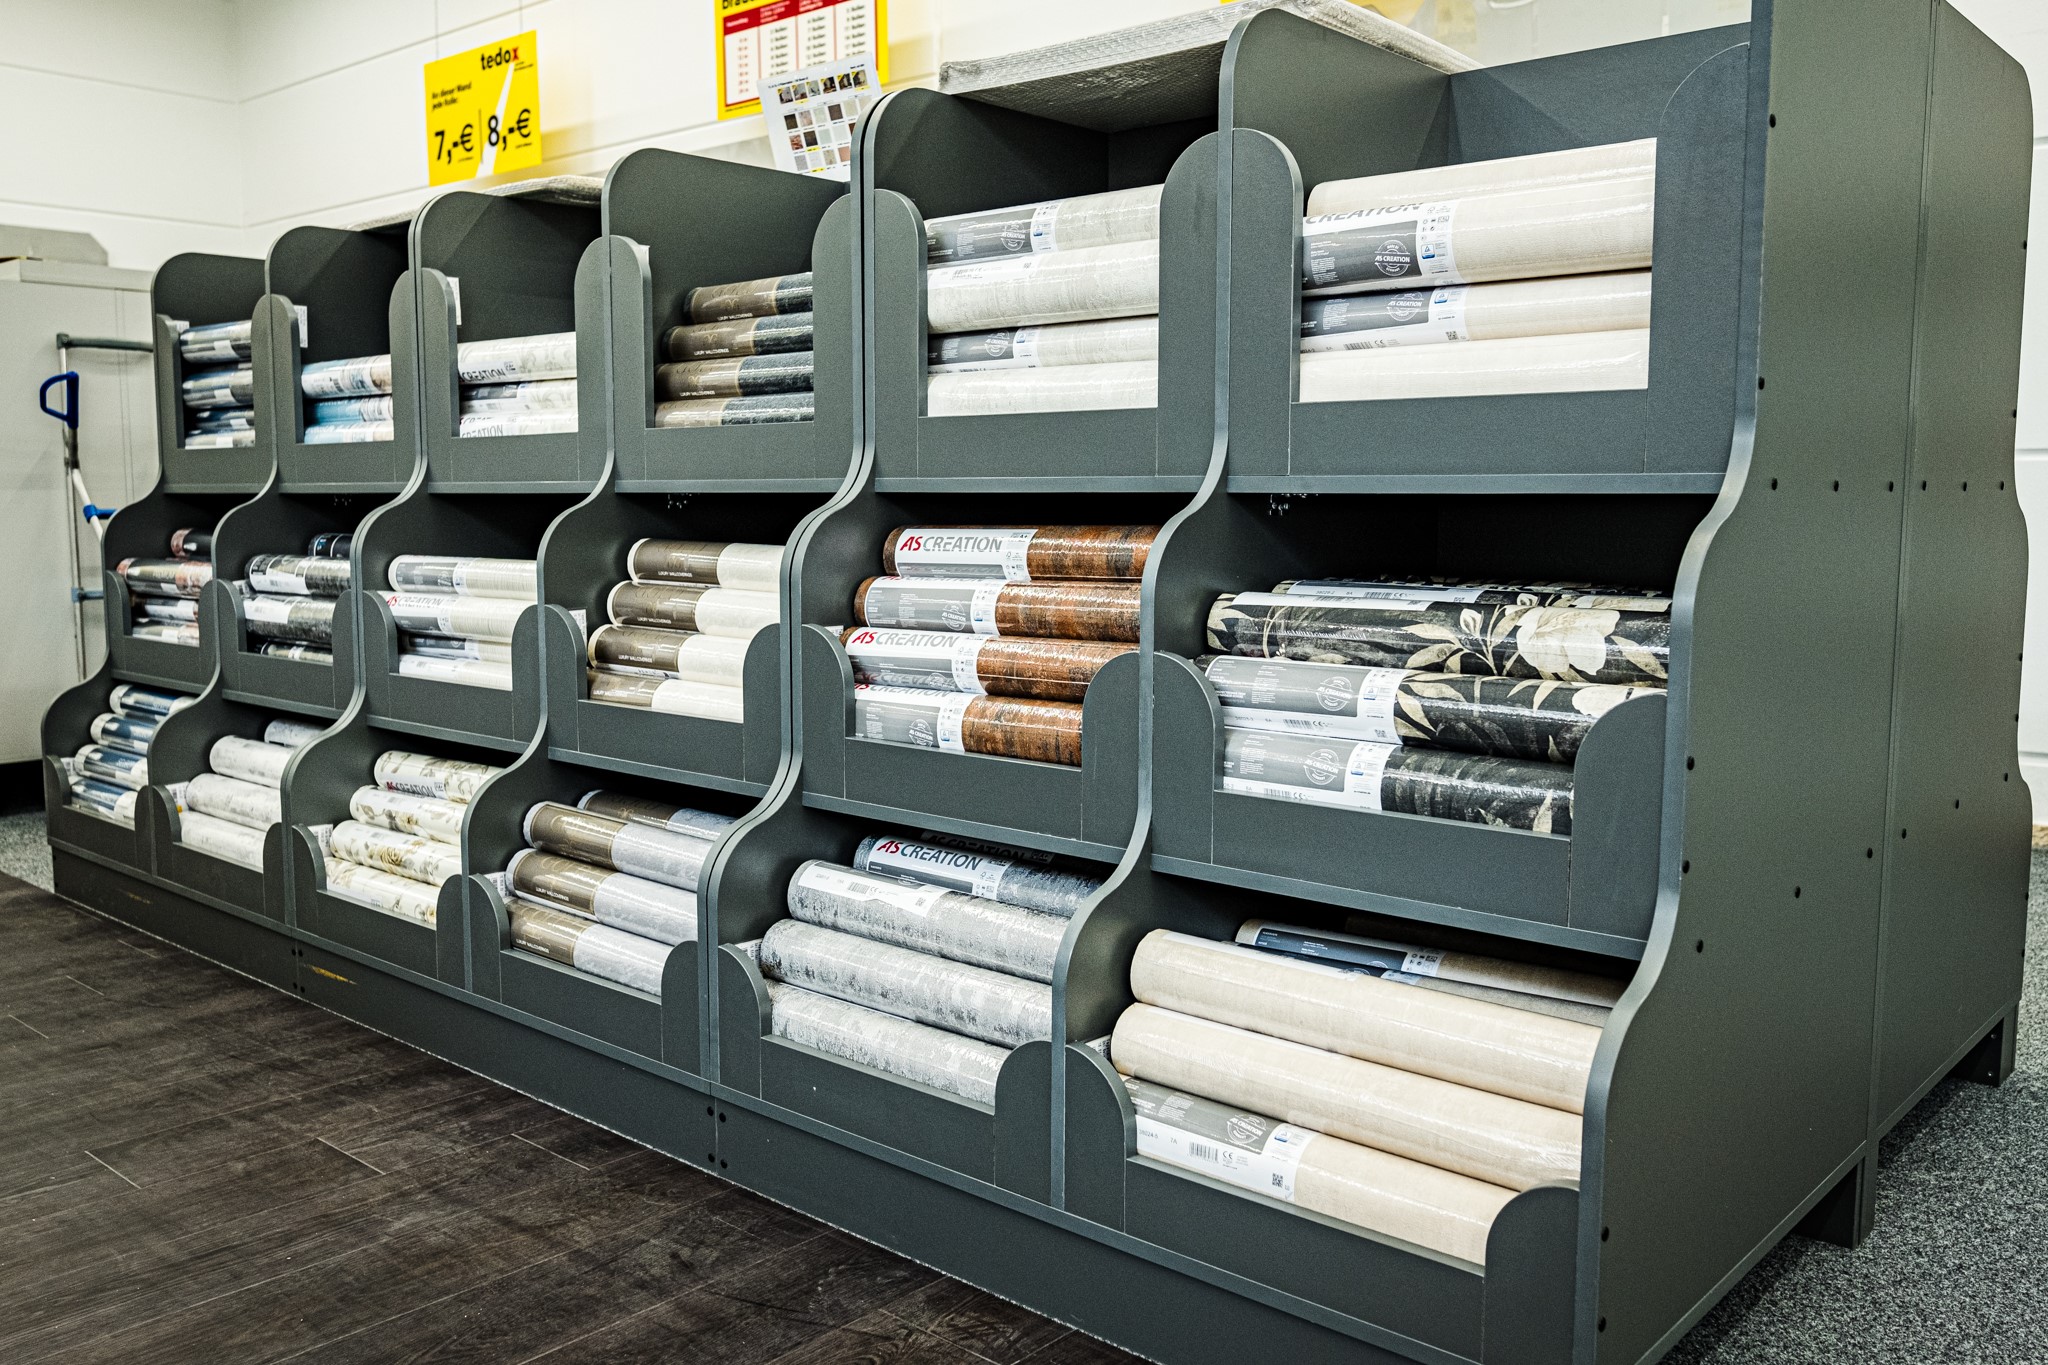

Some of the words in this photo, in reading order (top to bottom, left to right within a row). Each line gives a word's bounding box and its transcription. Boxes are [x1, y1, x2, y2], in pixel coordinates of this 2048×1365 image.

[481, 47, 519, 70] tedox
[1383, 255, 1410, 263] CREATION
[900, 536, 923, 552] AS
[923, 536, 1003, 553] CREATION
[852, 631, 877, 645] AS
[876, 632, 960, 648] CREATION
[876, 840, 900, 855] AS
[900, 843, 983, 871] CREATION
